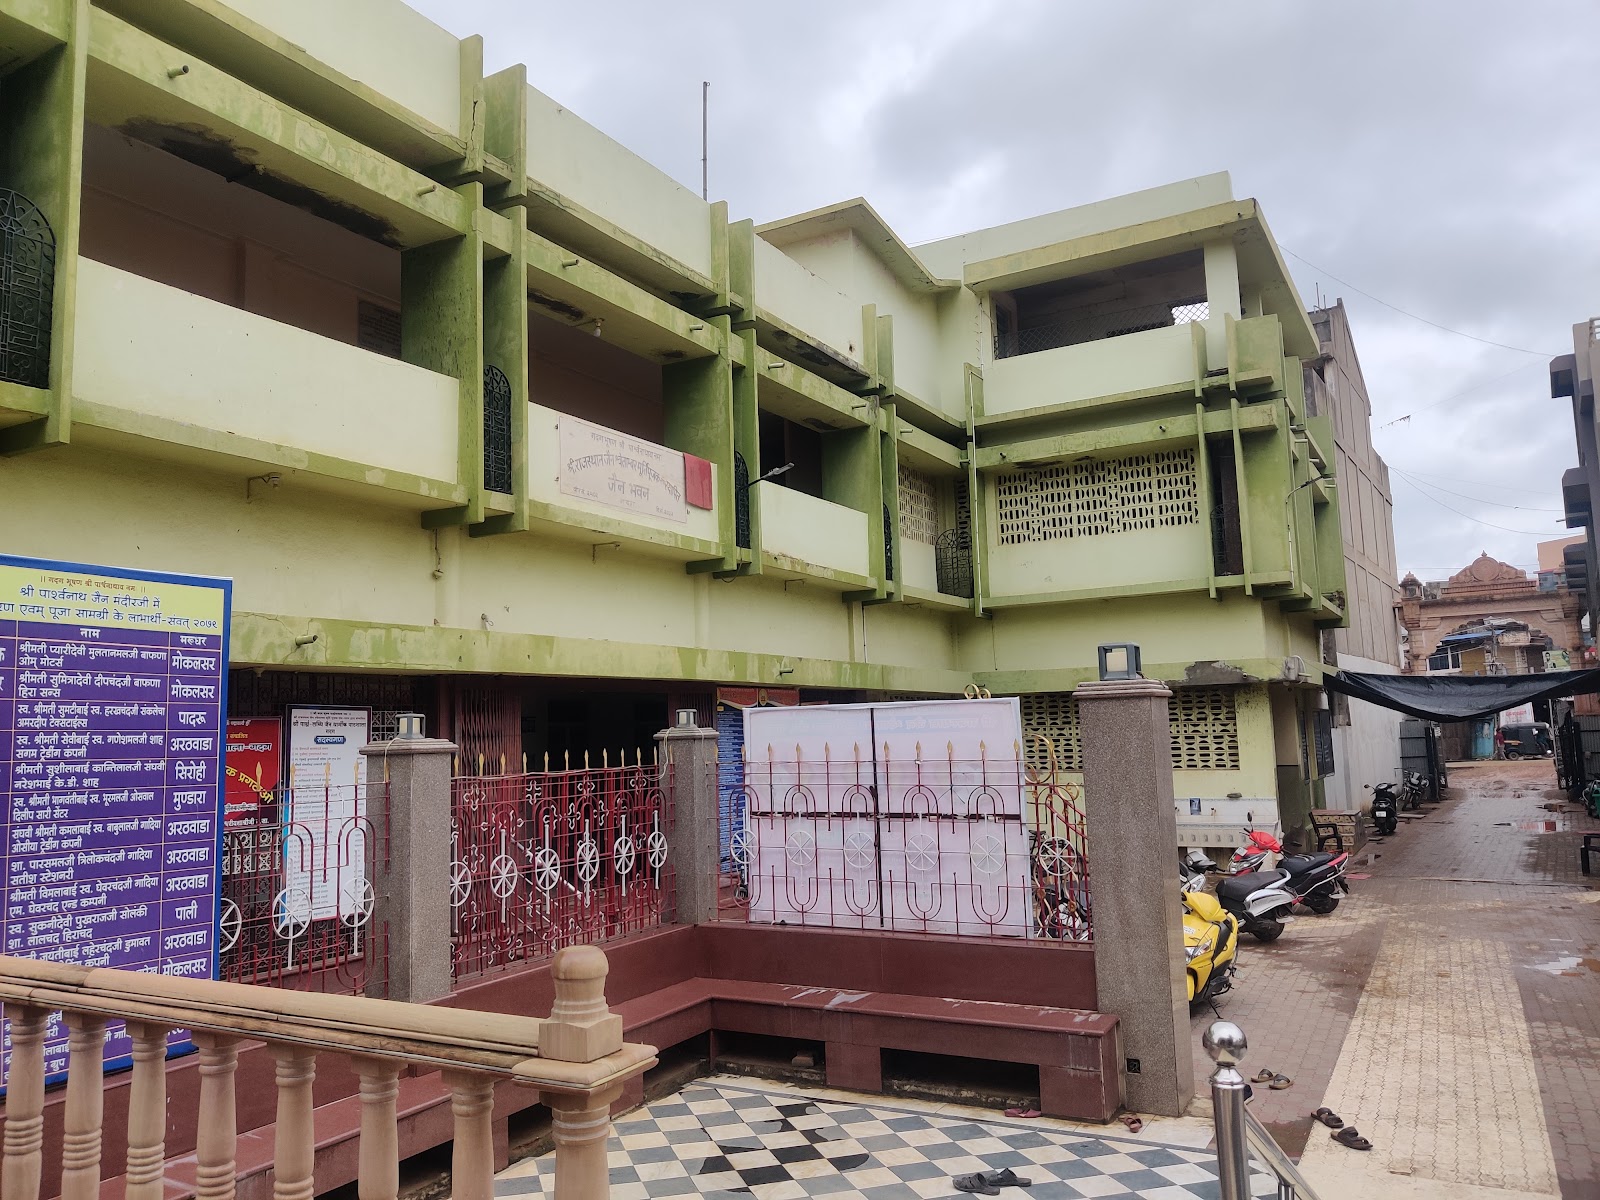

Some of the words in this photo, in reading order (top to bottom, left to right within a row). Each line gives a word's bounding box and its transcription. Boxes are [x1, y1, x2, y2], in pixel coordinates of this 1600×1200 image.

[604, 450, 615, 466] जैन
[608, 472, 626, 495] जैन
[630, 482, 650, 501] भवन
[84, 579, 92, 587] श्री
[20, 584, 34, 597] श्री
[92, 591, 109, 604] जैन
[114, 594, 149, 608] मंदीरजी
[20, 604, 45, 619] एवम्
[49, 606, 70, 620] पूजा
[76, 608, 109, 620] सामग्री
[113, 609, 124, 621] के
[80, 628, 101, 638] नाम
[20, 641, 47, 654] श्रीमती
[50, 643, 86, 657] प्यारीदेवी
[140, 651, 167, 660] बाफणा
[19, 654, 38, 669] ओम्
[40, 655, 64, 667] मोटर्स
[172, 650, 216, 670] मोकलसर
[19, 670, 47, 684] श्रीमती
[50, 672, 92, 687] सुमित्रादेवी
[94, 674, 132, 688] दीपचंदजी
[134, 678, 161, 688] बाफणा
[18, 684, 37, 698] हिरा
[40, 688, 61, 698] सन्स
[171, 679, 215, 698] मोकलसर
[18, 704, 30, 714] स्व.
[34, 702, 56, 714] श्रीमती
[91, 705, 102, 715] स्व.
[17, 715, 47, 729] अमरदीप
[178, 711, 207, 727] पादरू
[16, 735, 31, 745] स्व.
[34, 732, 59, 745] श्रीमती
[61, 732, 90, 746] सेवीबाई
[92, 735, 104, 745] स्व.
[107, 732, 148, 744] गणेशमलजी
[150, 735, 163, 745] शाह
[171, 738, 213, 752] अरठवाडा
[16, 746, 38, 758] संगम
[64, 745, 87, 758] कंपनी
[15, 763, 43, 774] श्रीमती
[46, 762, 90, 776] सुशीलाबाई
[92, 761, 141, 773] कान्तिलालजी
[144, 760, 165, 771] संघवी
[175, 760, 206, 781] सिरोही
[14, 777, 52, 789] नरेशभाई
[82, 778, 99, 788] शाह
[14, 798, 26, 807] स्व.
[29, 793, 50, 806] श्रीमती
[52, 791, 88, 805] भागवंतीबाई
[90, 794, 101, 804] स्व.
[130, 789, 154, 801] ओसवाल
[173, 791, 206, 811] मुण्डारा
[13, 808, 34, 822] दिलीप
[36, 806, 52, 819] सारी
[12, 825, 33, 839] संघवी
[35, 823, 57, 837] श्रीमती
[59, 821, 92, 836] कमलाबाई
[93, 824, 104, 833] स्व.
[107, 818, 139, 835] बाबुलालजी
[140, 817, 162, 831] गादिया
[167, 820, 210, 836] अरठवाडा
[12, 839, 38, 853] ओसीया
[61, 835, 82, 848] कंपनी
[11, 861, 26, 872] शा.
[29, 853, 75, 870] पारसमलजी
[77, 849, 125, 866] त्रिलोकचंदजी
[127, 847, 153, 861] गादिया
[166, 847, 209, 864] अरठवाडा
[10, 871, 37, 885] सतीश
[39, 867, 74, 883] स्टेशनरी
[166, 874, 209, 892] अरठवाडा
[10, 887, 37, 902] श्रीमती
[39, 882, 78, 899] विमलाबाई
[79, 884, 93, 894] स्व.
[96, 877, 132, 892] घेवरचंदजी
[134, 875, 159, 888] गादिया
[9, 906, 25, 918] एम.
[28, 899, 59, 913] घेवरचंद
[61, 900, 78, 912] एन्ड
[80, 893, 107, 907] कम्पनी
[175, 900, 198, 921] पाली
[8, 924, 25, 934] स्व.
[28, 914, 73, 935] सुकनीदेवी
[76, 908, 117, 929] पुखराजजी
[119, 905, 148, 920] सोलंकी
[8, 939, 24, 949] शा.
[28, 930, 60, 946] लालचंद
[63, 926, 93, 943] हिराचंद
[164, 930, 207, 950] अरठवाडा
[82, 938, 122, 956] लहेरचंदजी
[162, 958, 207, 976] मोकलसर
